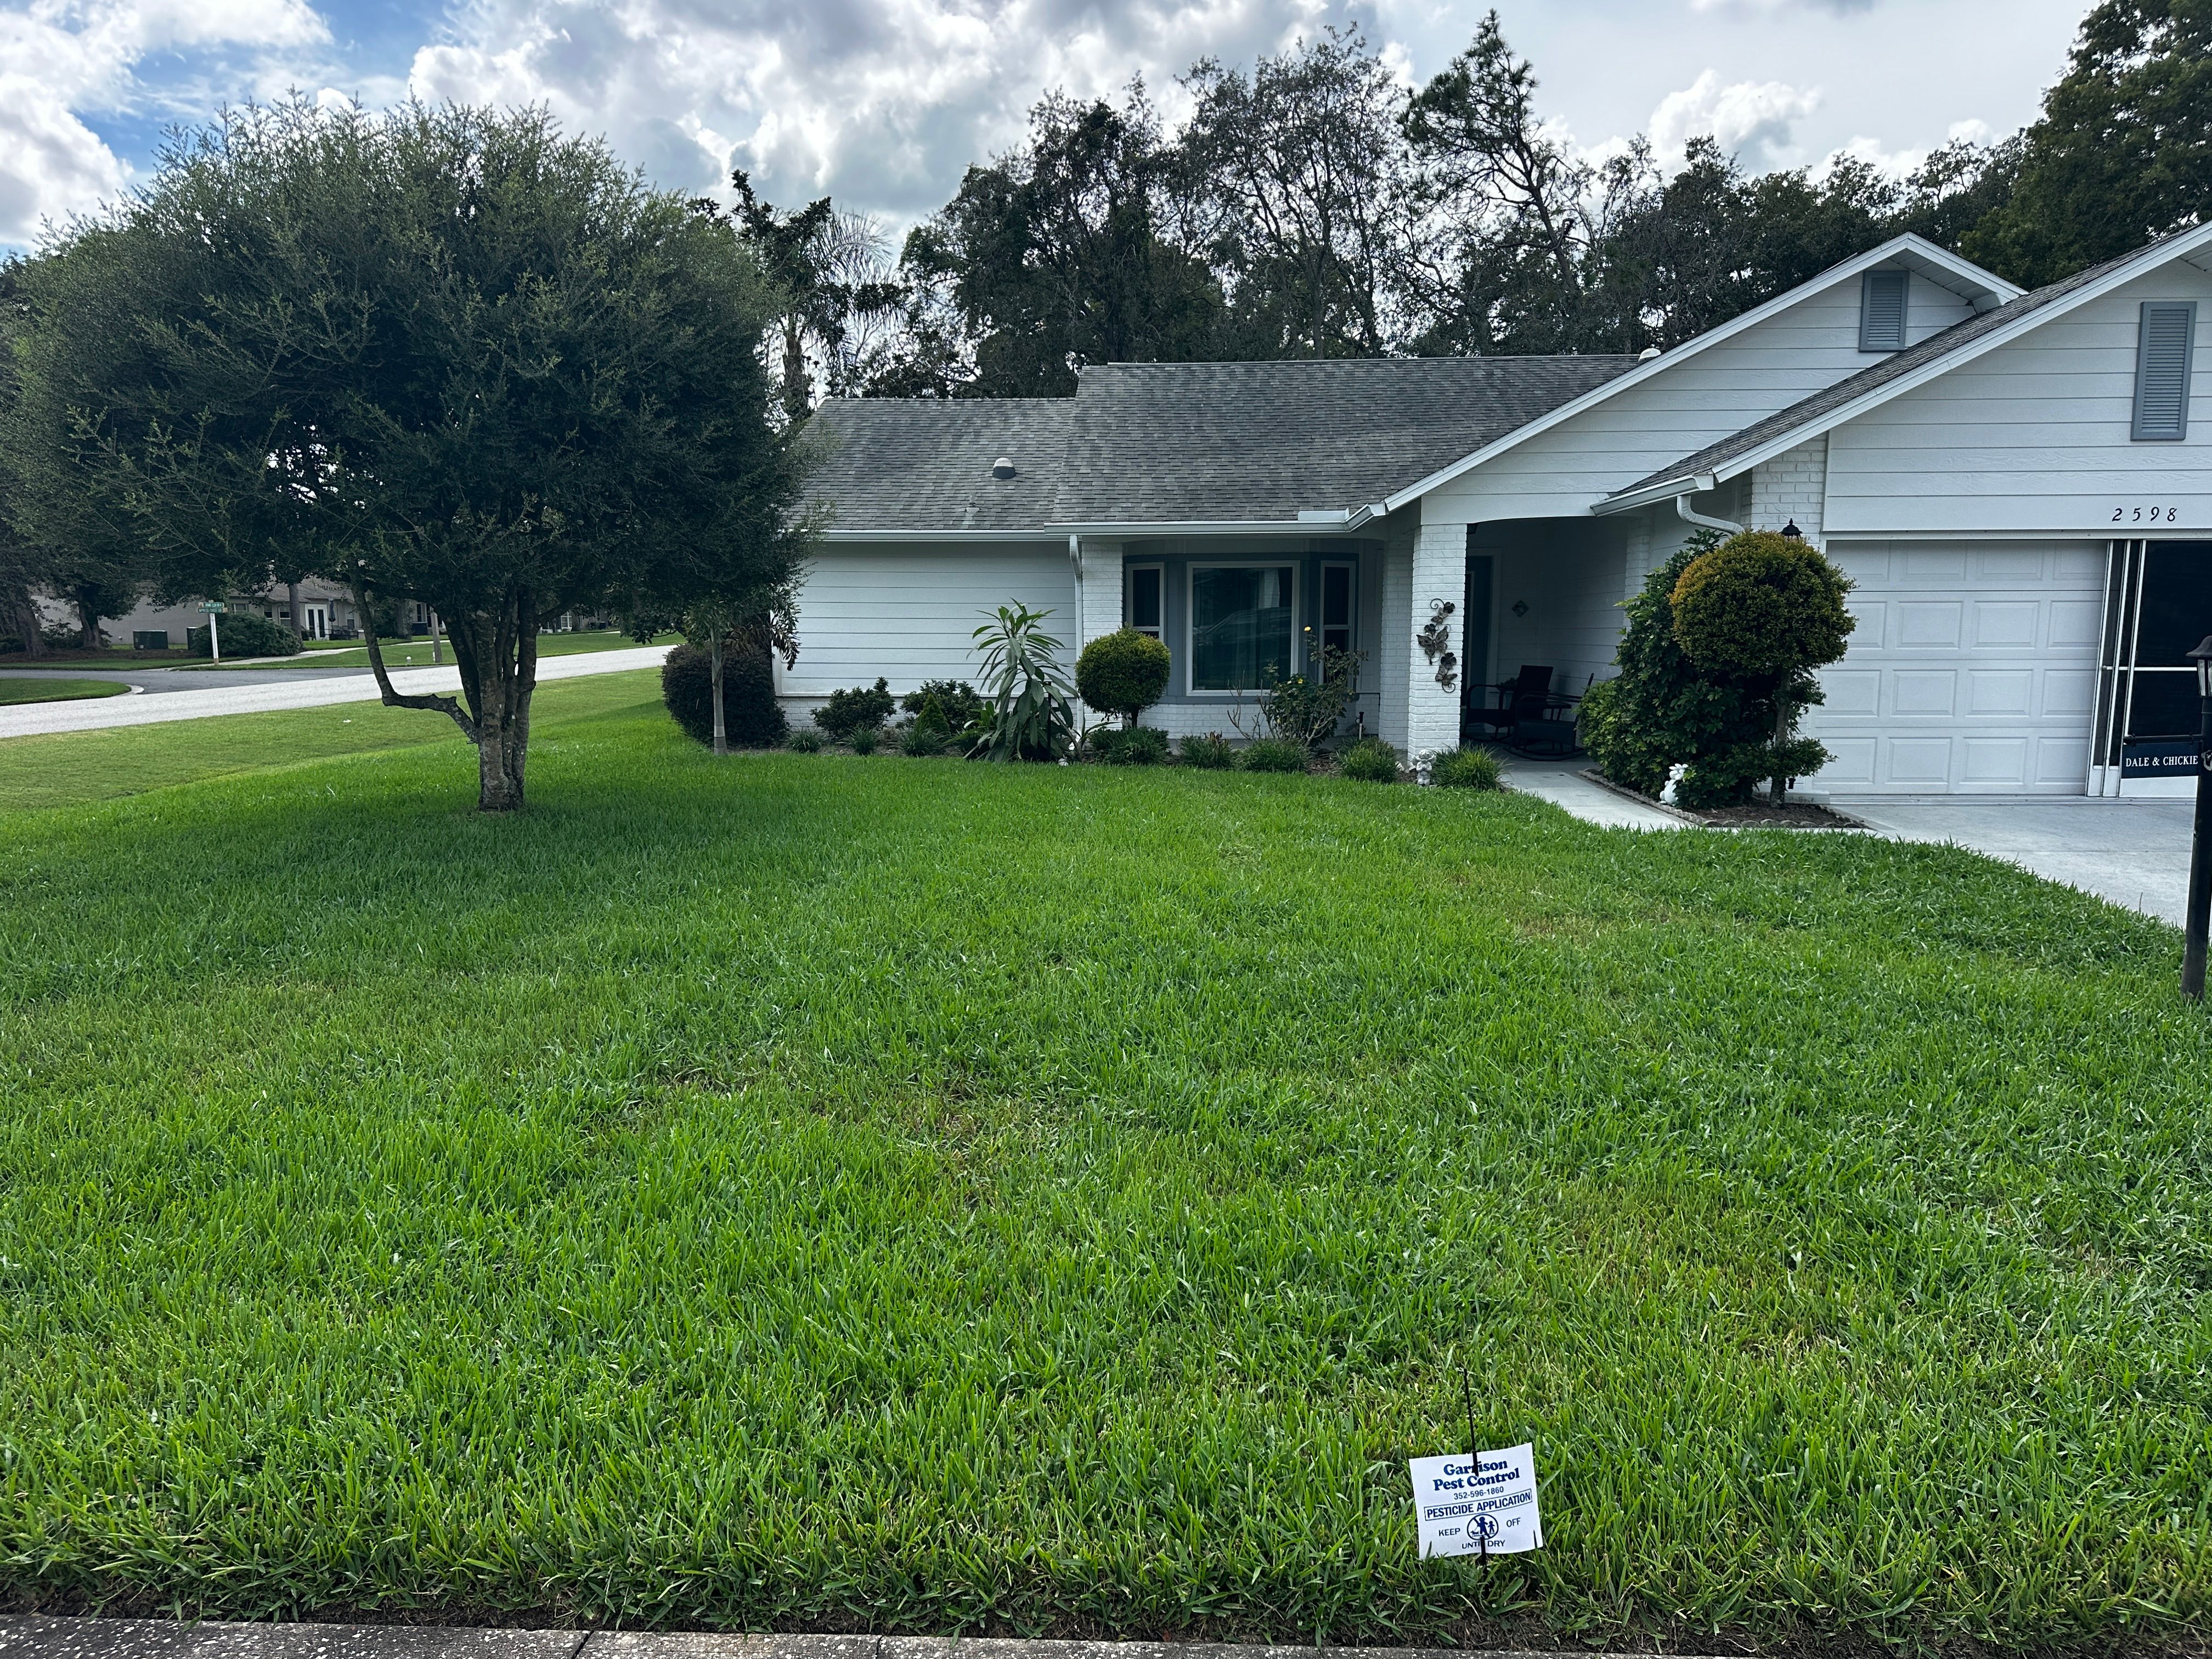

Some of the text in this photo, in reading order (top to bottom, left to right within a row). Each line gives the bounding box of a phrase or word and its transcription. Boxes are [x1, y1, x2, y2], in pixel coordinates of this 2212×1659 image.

[2112, 506, 2177, 522] 2598
[2125, 755, 2198, 767] DALE & CHICKIE
[1432, 1468, 1520, 1491] Pest Control
[1453, 1486, 1504, 1500] 352-596-1860
[1426, 1491, 1531, 1519] PESTICIDE APPLICATION
[1438, 1517, 1521, 1537] KEEP OFF
[1462, 1539, 1505, 1549] UNTI DRY
